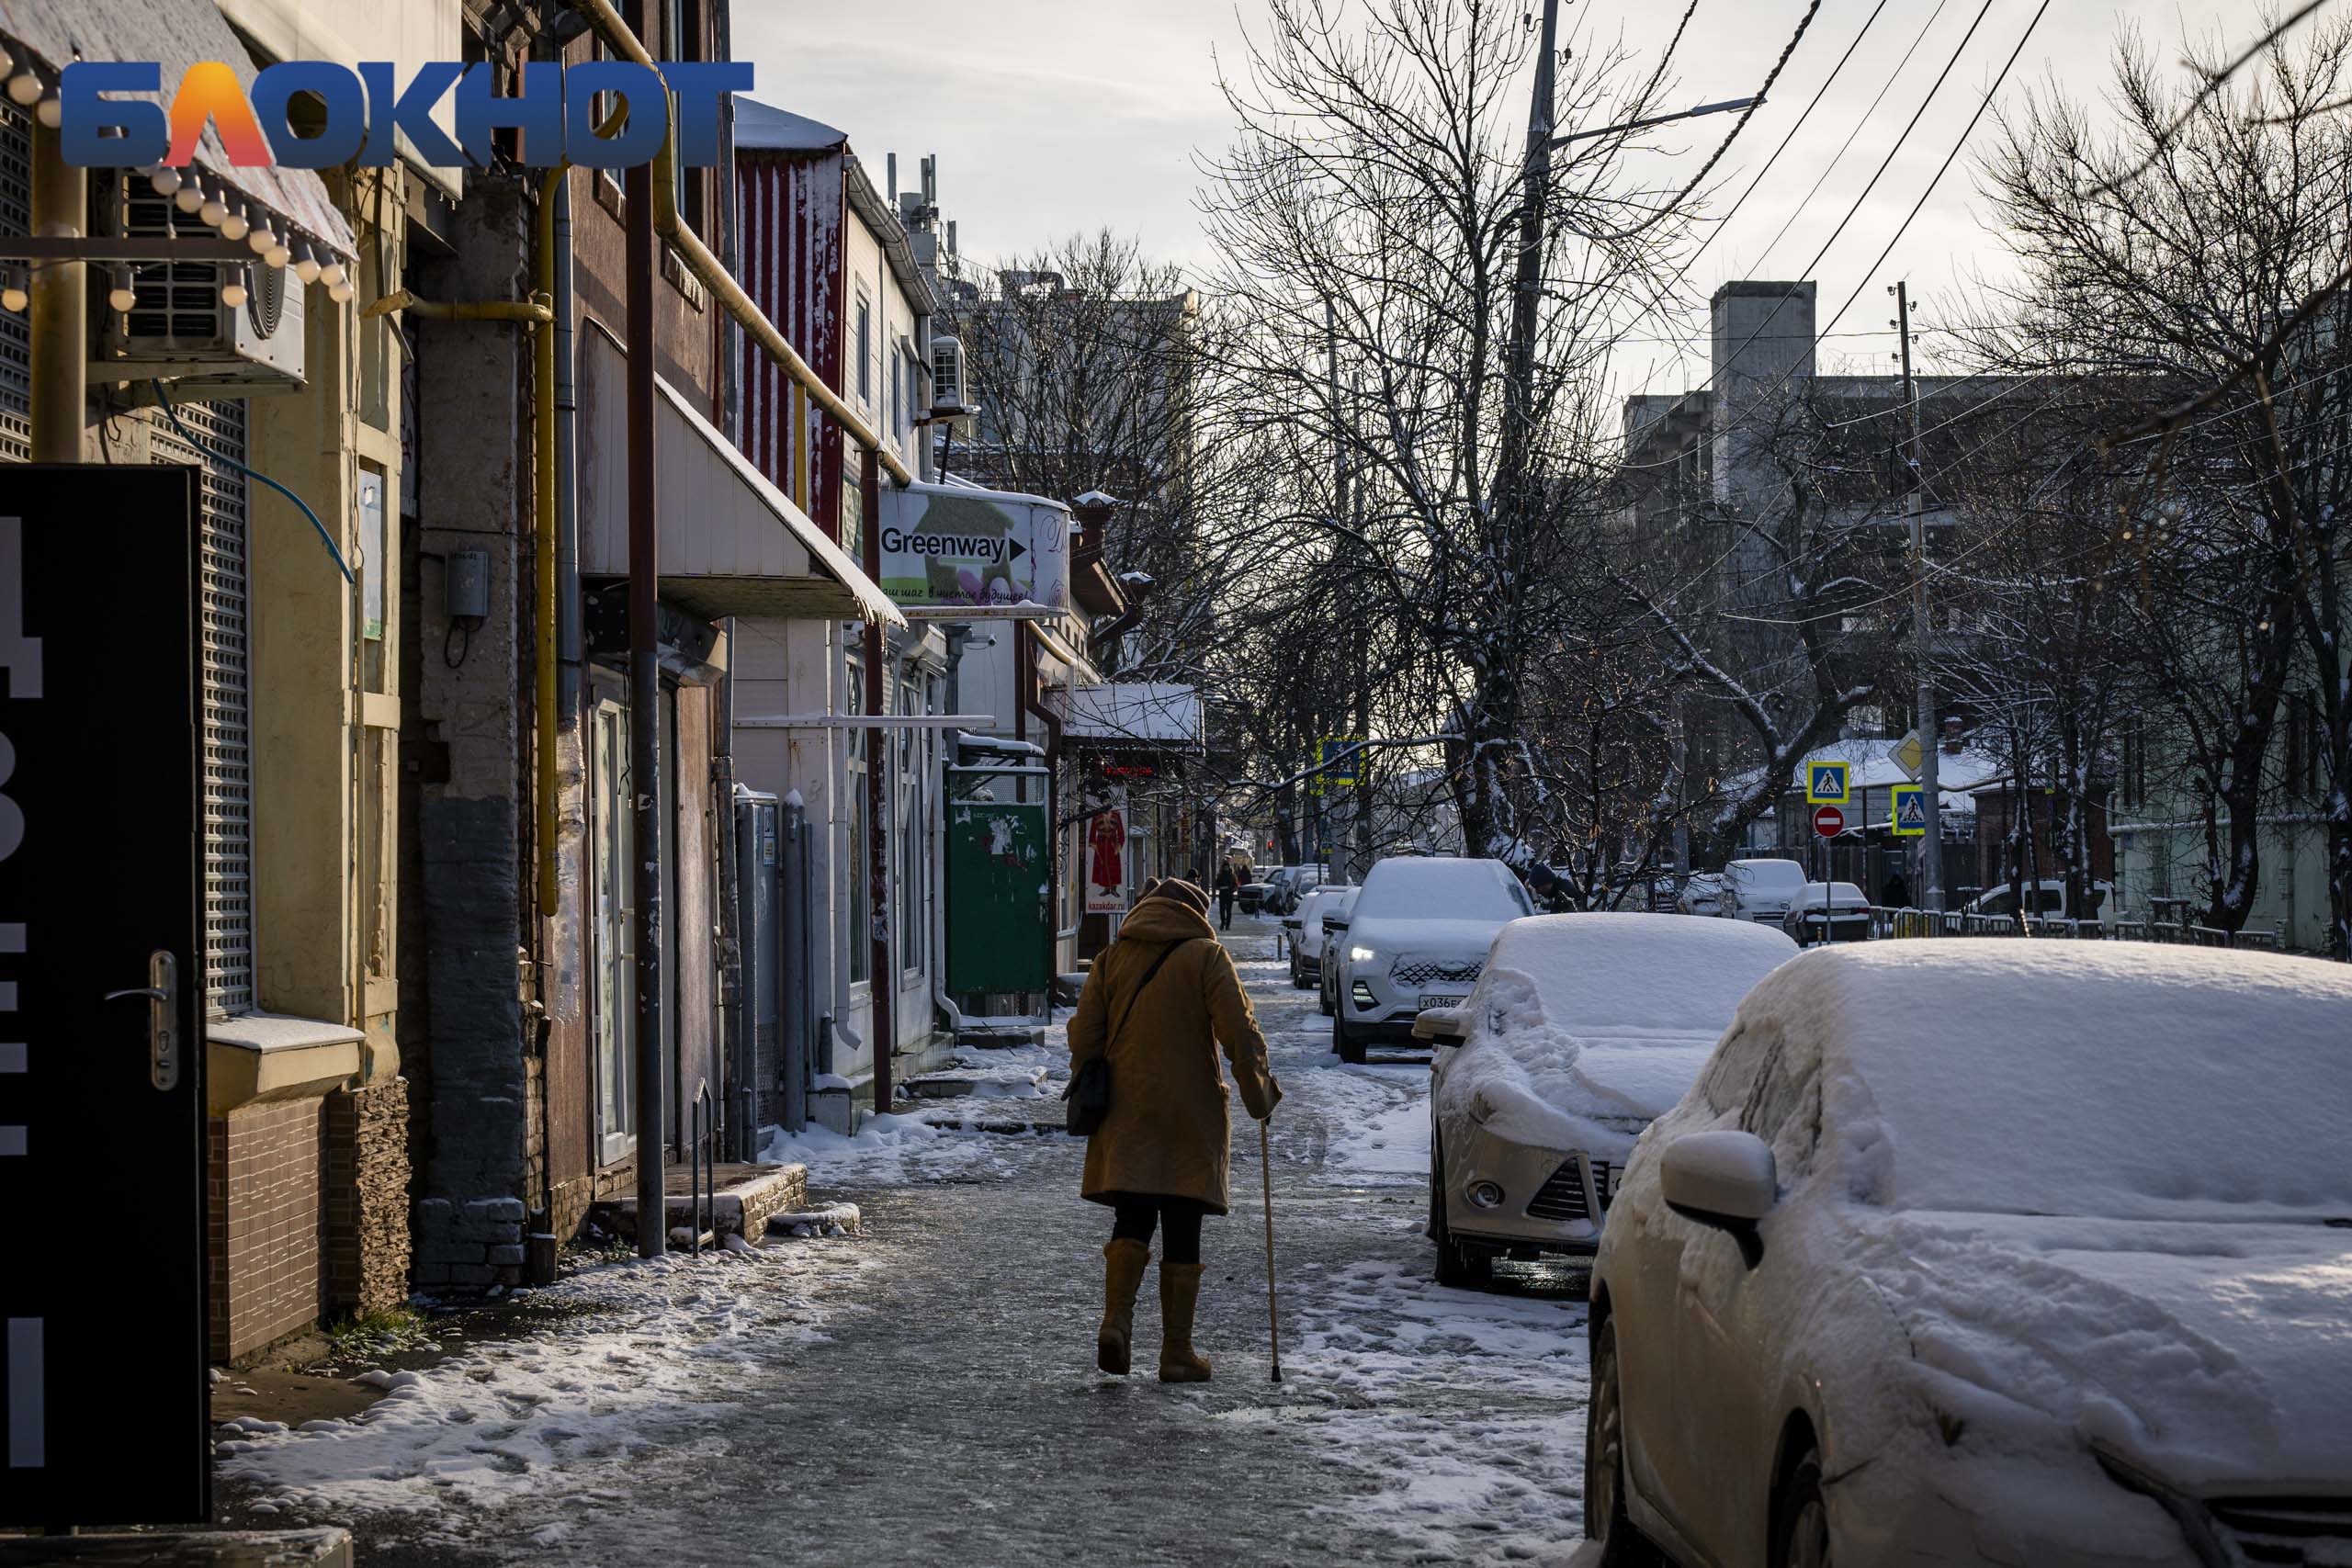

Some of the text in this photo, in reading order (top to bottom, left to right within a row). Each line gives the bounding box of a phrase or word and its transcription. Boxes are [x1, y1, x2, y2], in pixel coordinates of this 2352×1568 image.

[881, 527, 1005, 564] Greenway
[882, 588, 899, 597] аш
[901, 588, 923, 598] шаг
[937, 588, 978, 600] чистое
[979, 587, 1029, 604] будущее!
